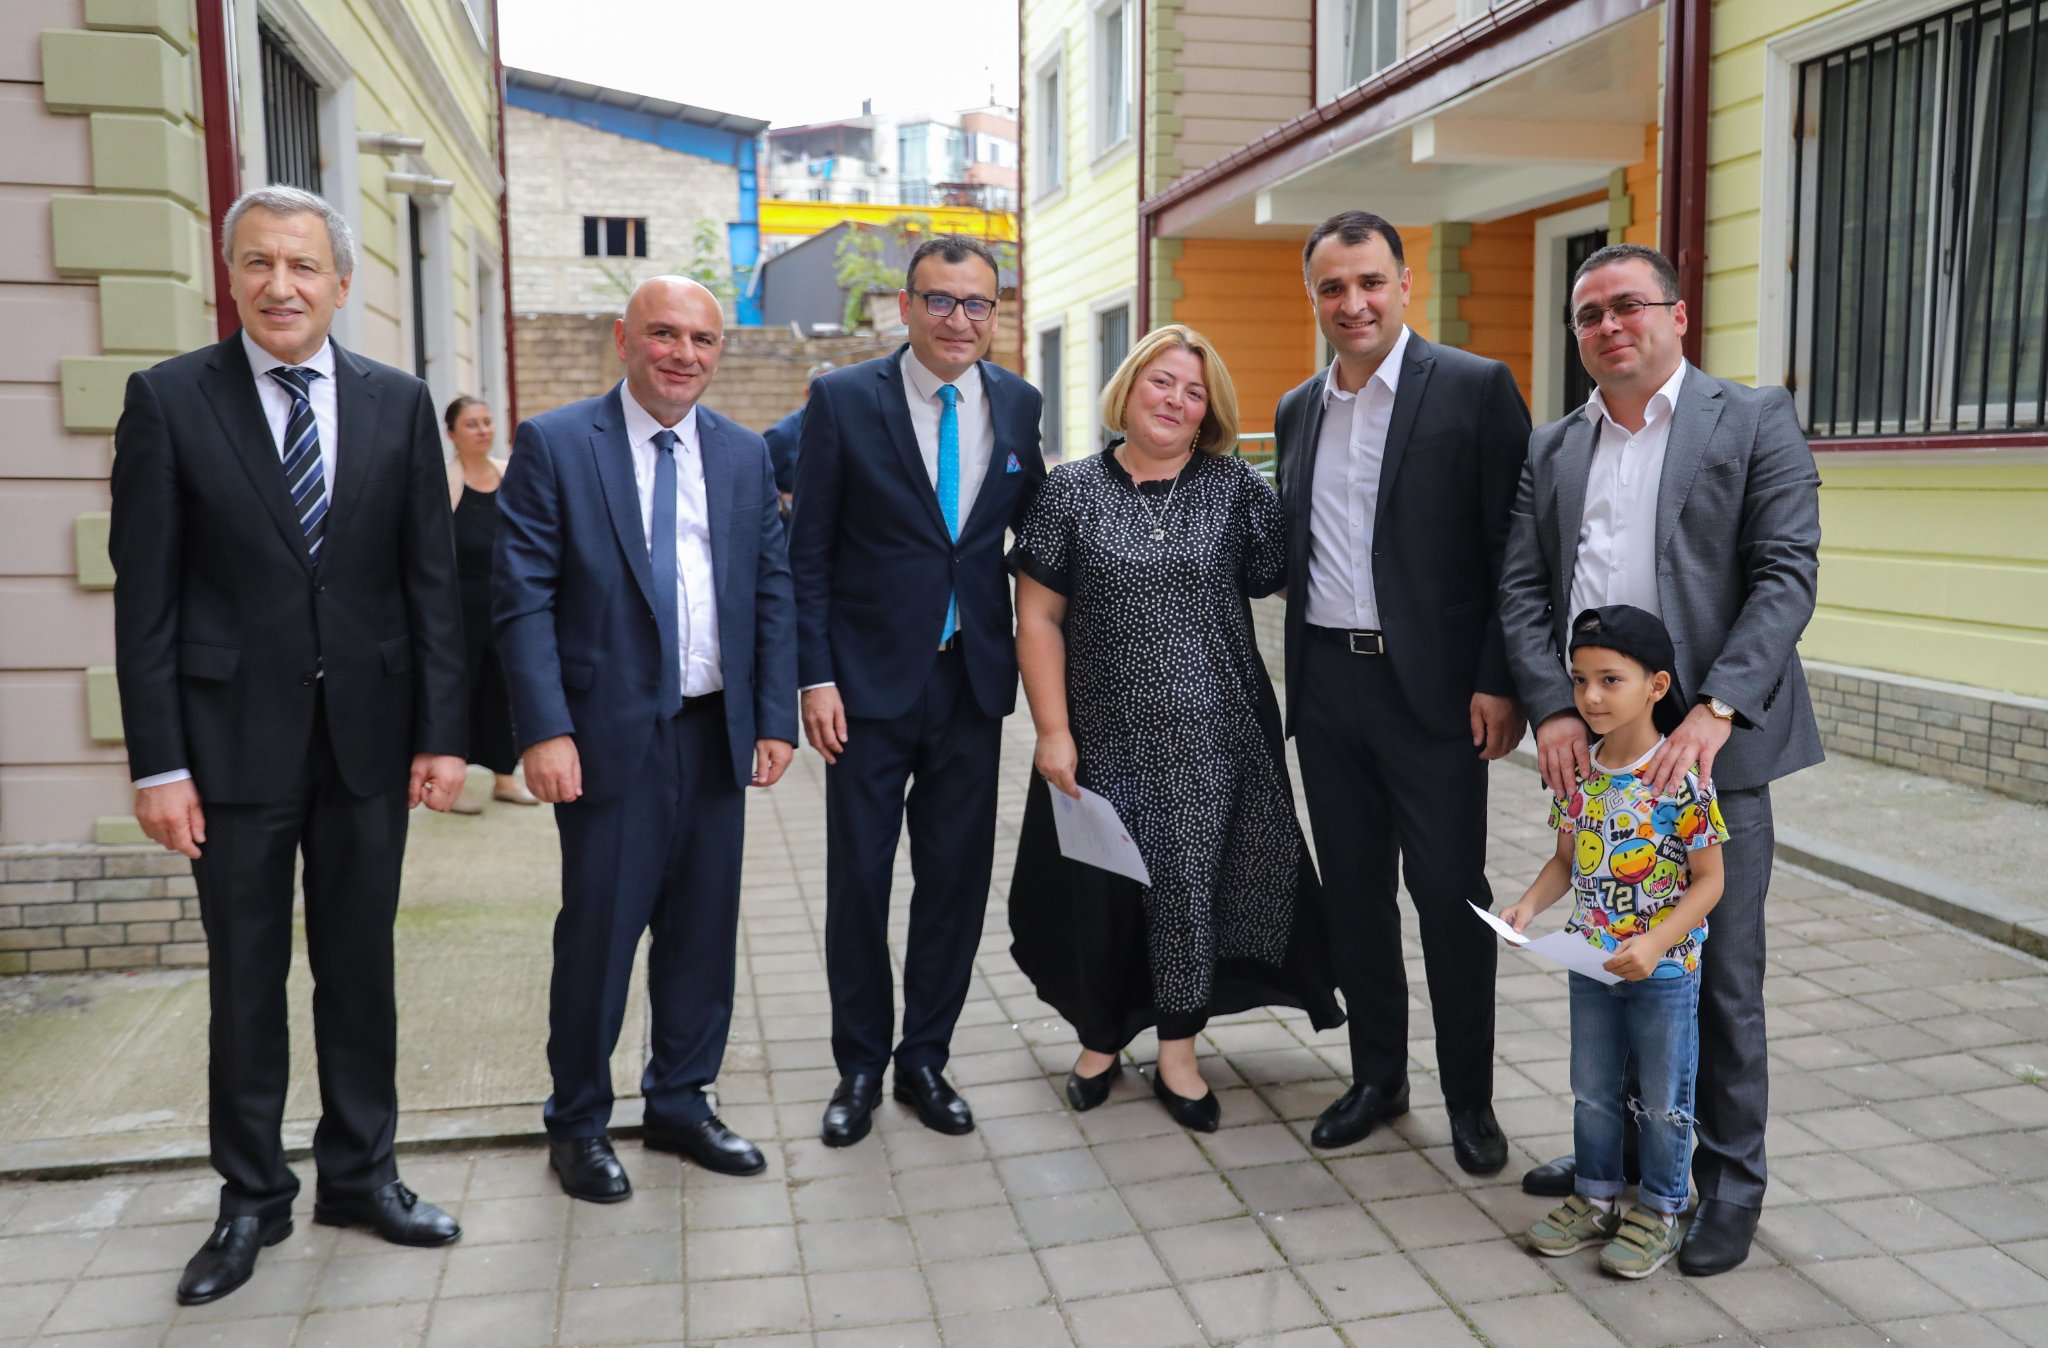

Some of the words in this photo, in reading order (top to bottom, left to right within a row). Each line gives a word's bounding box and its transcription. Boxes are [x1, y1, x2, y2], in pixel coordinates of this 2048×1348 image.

[1594, 786, 1625, 816] 72
[1609, 818, 1615, 831] I
[1610, 828, 1635, 842] SW
[1601, 880, 1633, 913] 72
